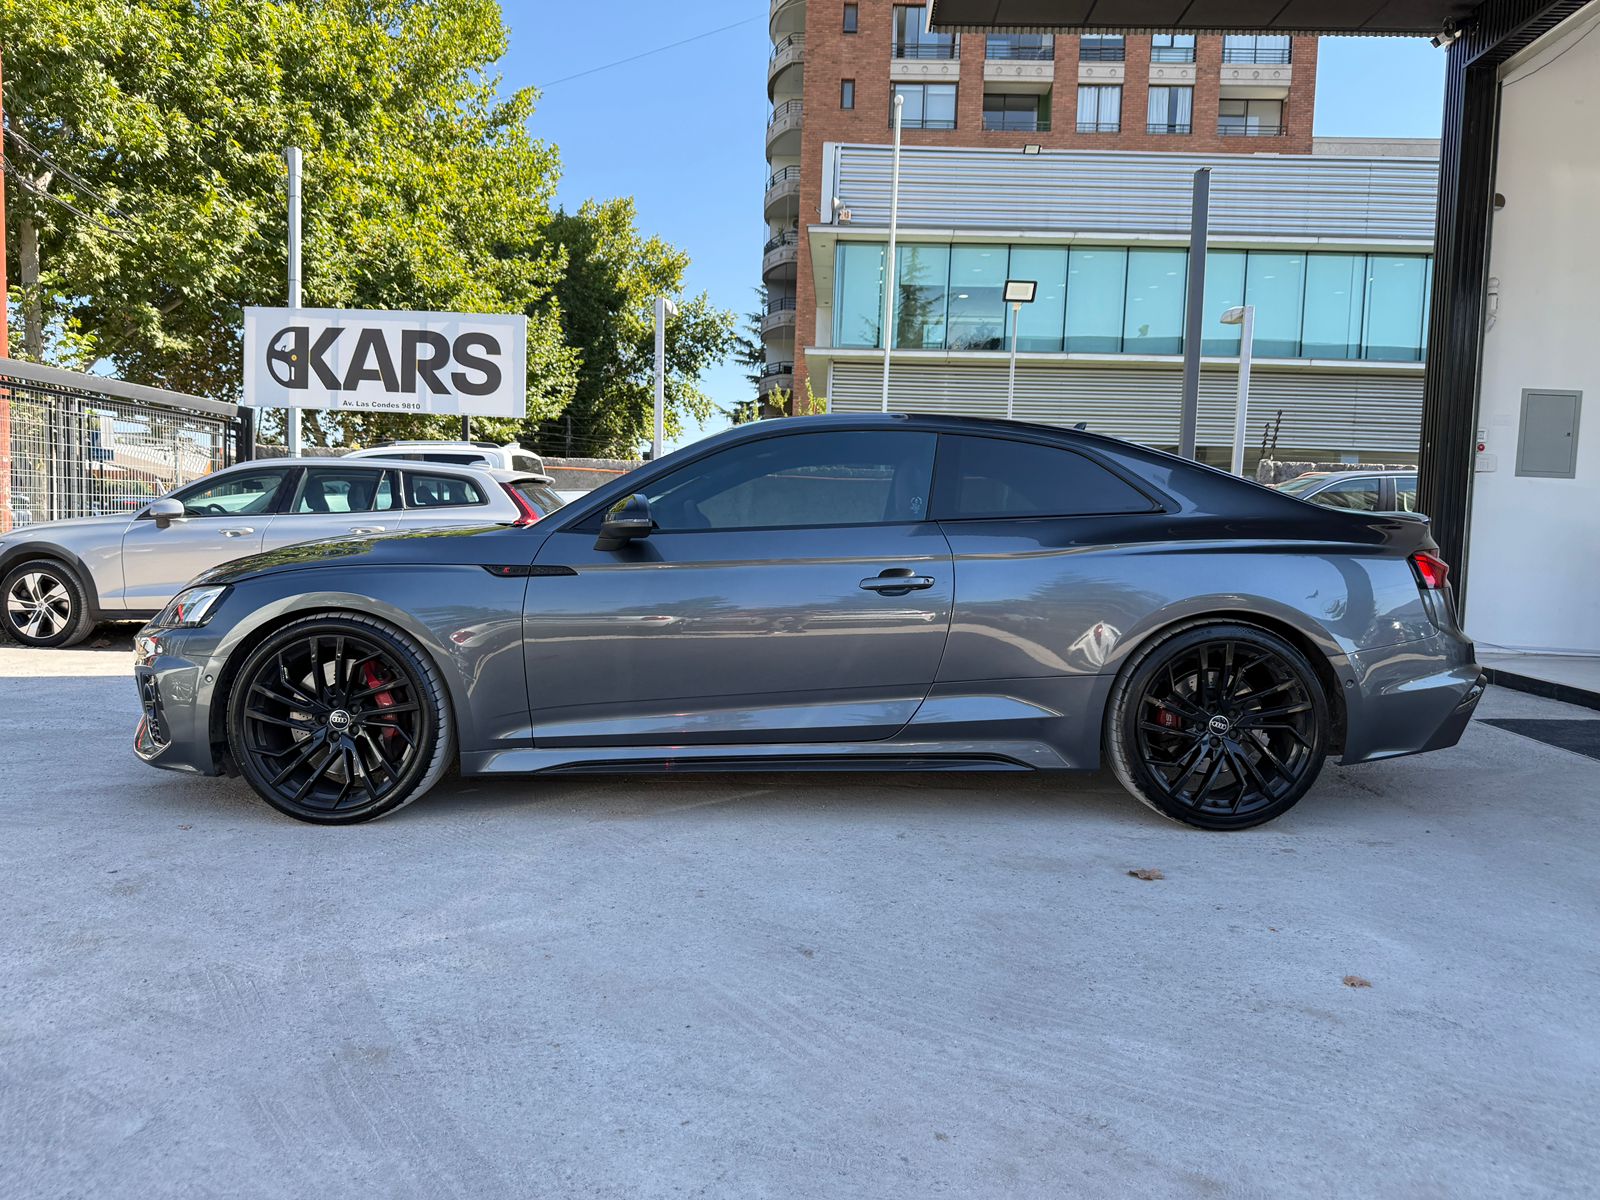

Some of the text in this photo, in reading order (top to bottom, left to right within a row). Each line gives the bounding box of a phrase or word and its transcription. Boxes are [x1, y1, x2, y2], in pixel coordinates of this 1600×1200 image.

[309, 327, 502, 396] KARS
[356, 400, 370, 408] Las
[371, 401, 400, 409] Condes
[401, 402, 421, 410] 9810
